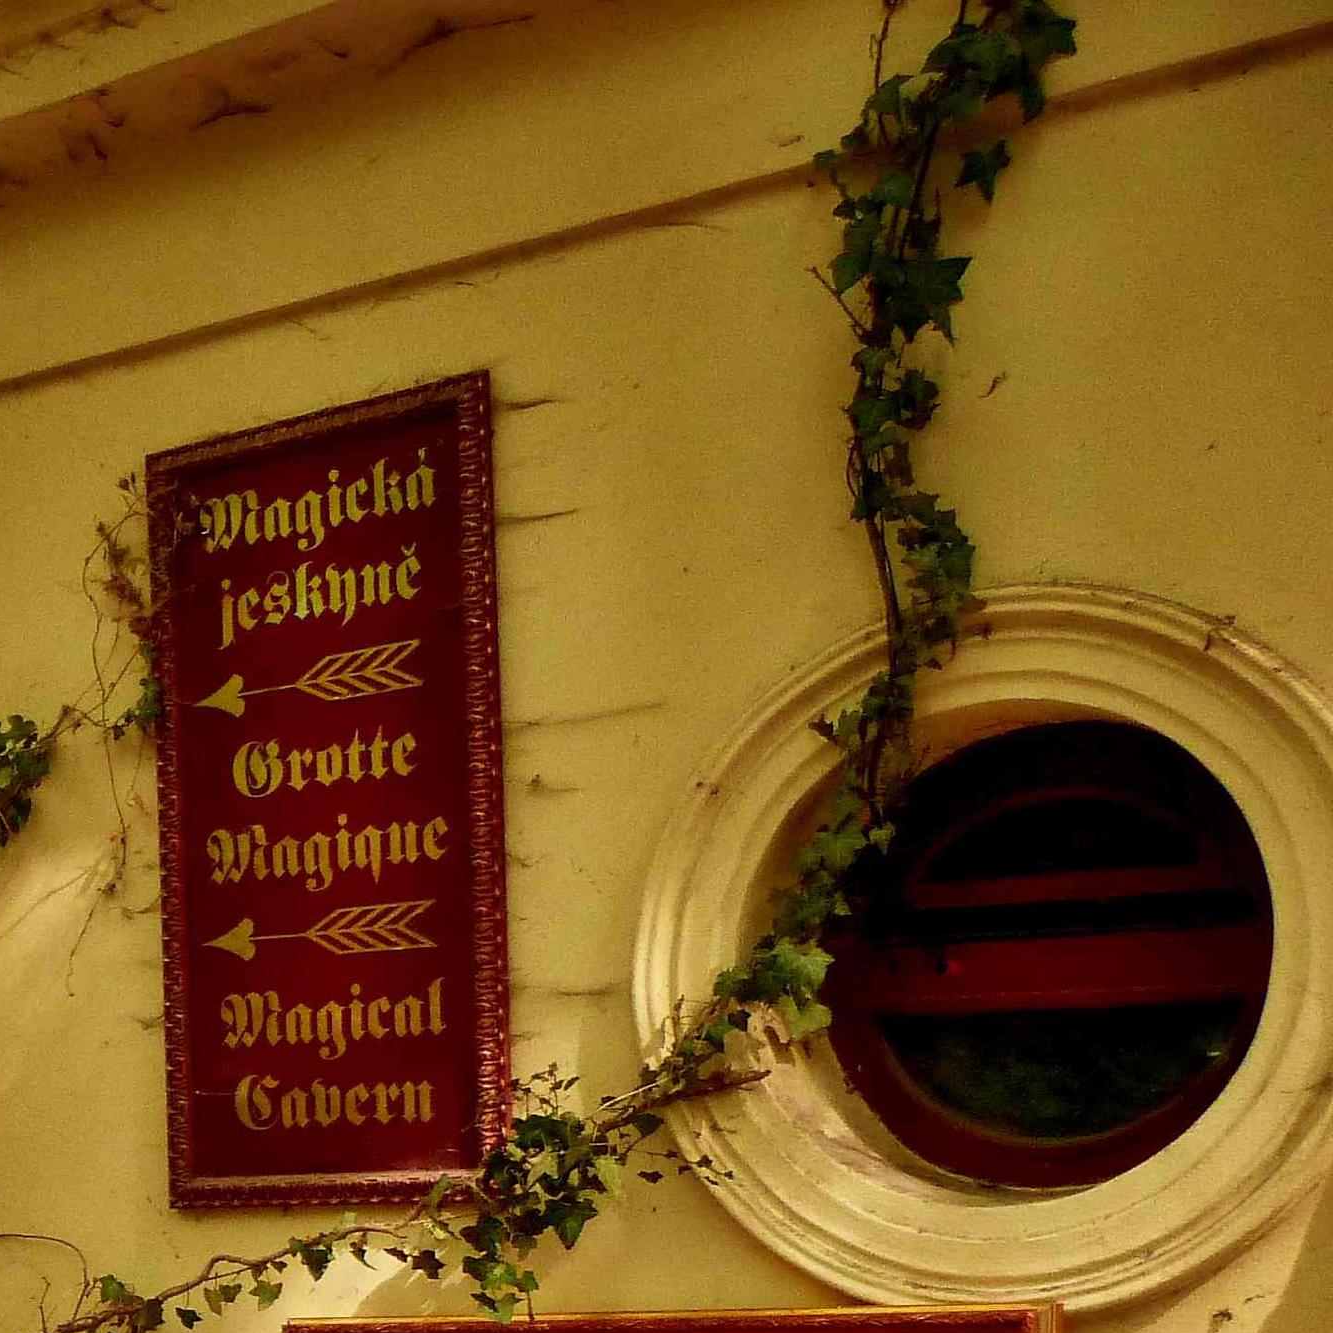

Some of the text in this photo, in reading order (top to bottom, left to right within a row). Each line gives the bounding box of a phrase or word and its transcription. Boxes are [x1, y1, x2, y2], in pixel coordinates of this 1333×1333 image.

[198, 449, 435, 552] Magická
[219, 542, 420, 650] jeskyně
[232, 728, 417, 798] Grotte
[207, 813, 448, 889] Magique
[221, 977, 445, 1058] Magical
[235, 1074, 434, 1131] Cavern
